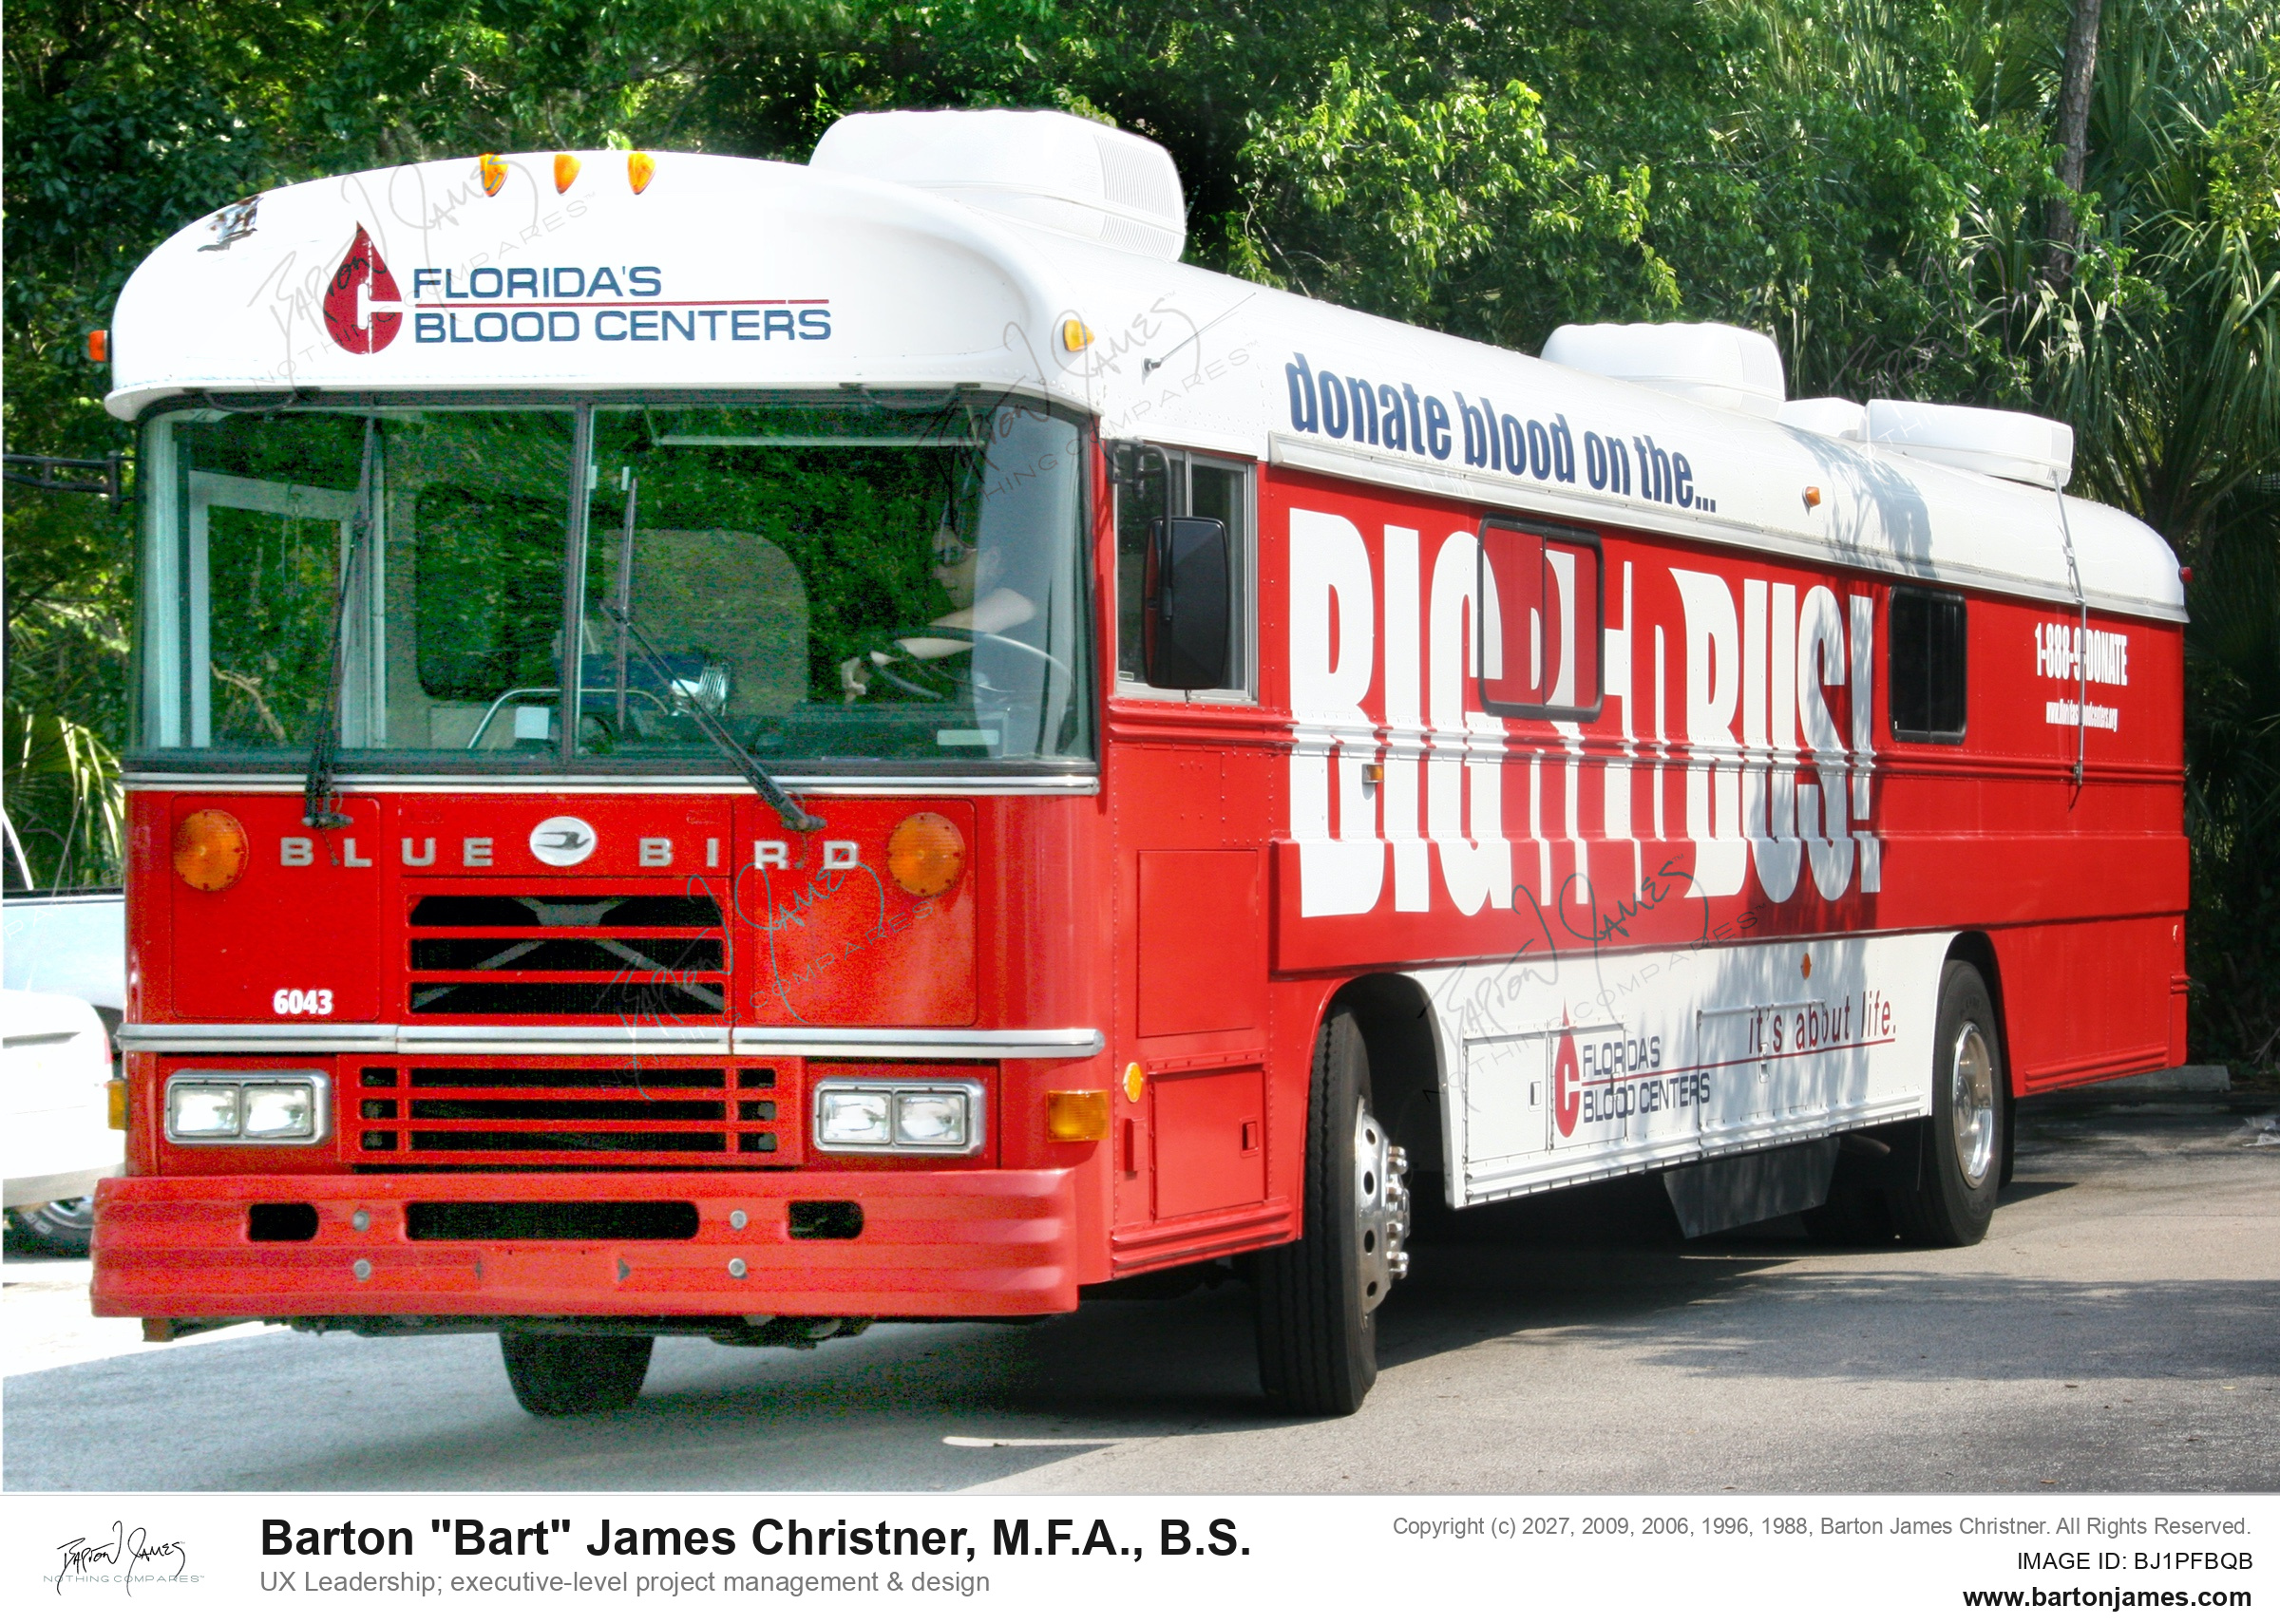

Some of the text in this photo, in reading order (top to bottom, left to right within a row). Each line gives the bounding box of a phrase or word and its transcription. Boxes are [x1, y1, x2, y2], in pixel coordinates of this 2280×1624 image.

[413, 265, 662, 299] FLORIDA'S
[415, 308, 831, 345] BLOOD CENTERS
[1285, 351, 1717, 513] donate blood on the...
[1288, 506, 1511, 918] BIG
[1668, 566, 1881, 903] BUS!
[279, 836, 859, 870] BLUE BIRD
[273, 989, 332, 1015] 6043
[1749, 990, 1896, 1054] it's about life.
[1583, 1072, 1711, 1124] BLOOD CENTERS
